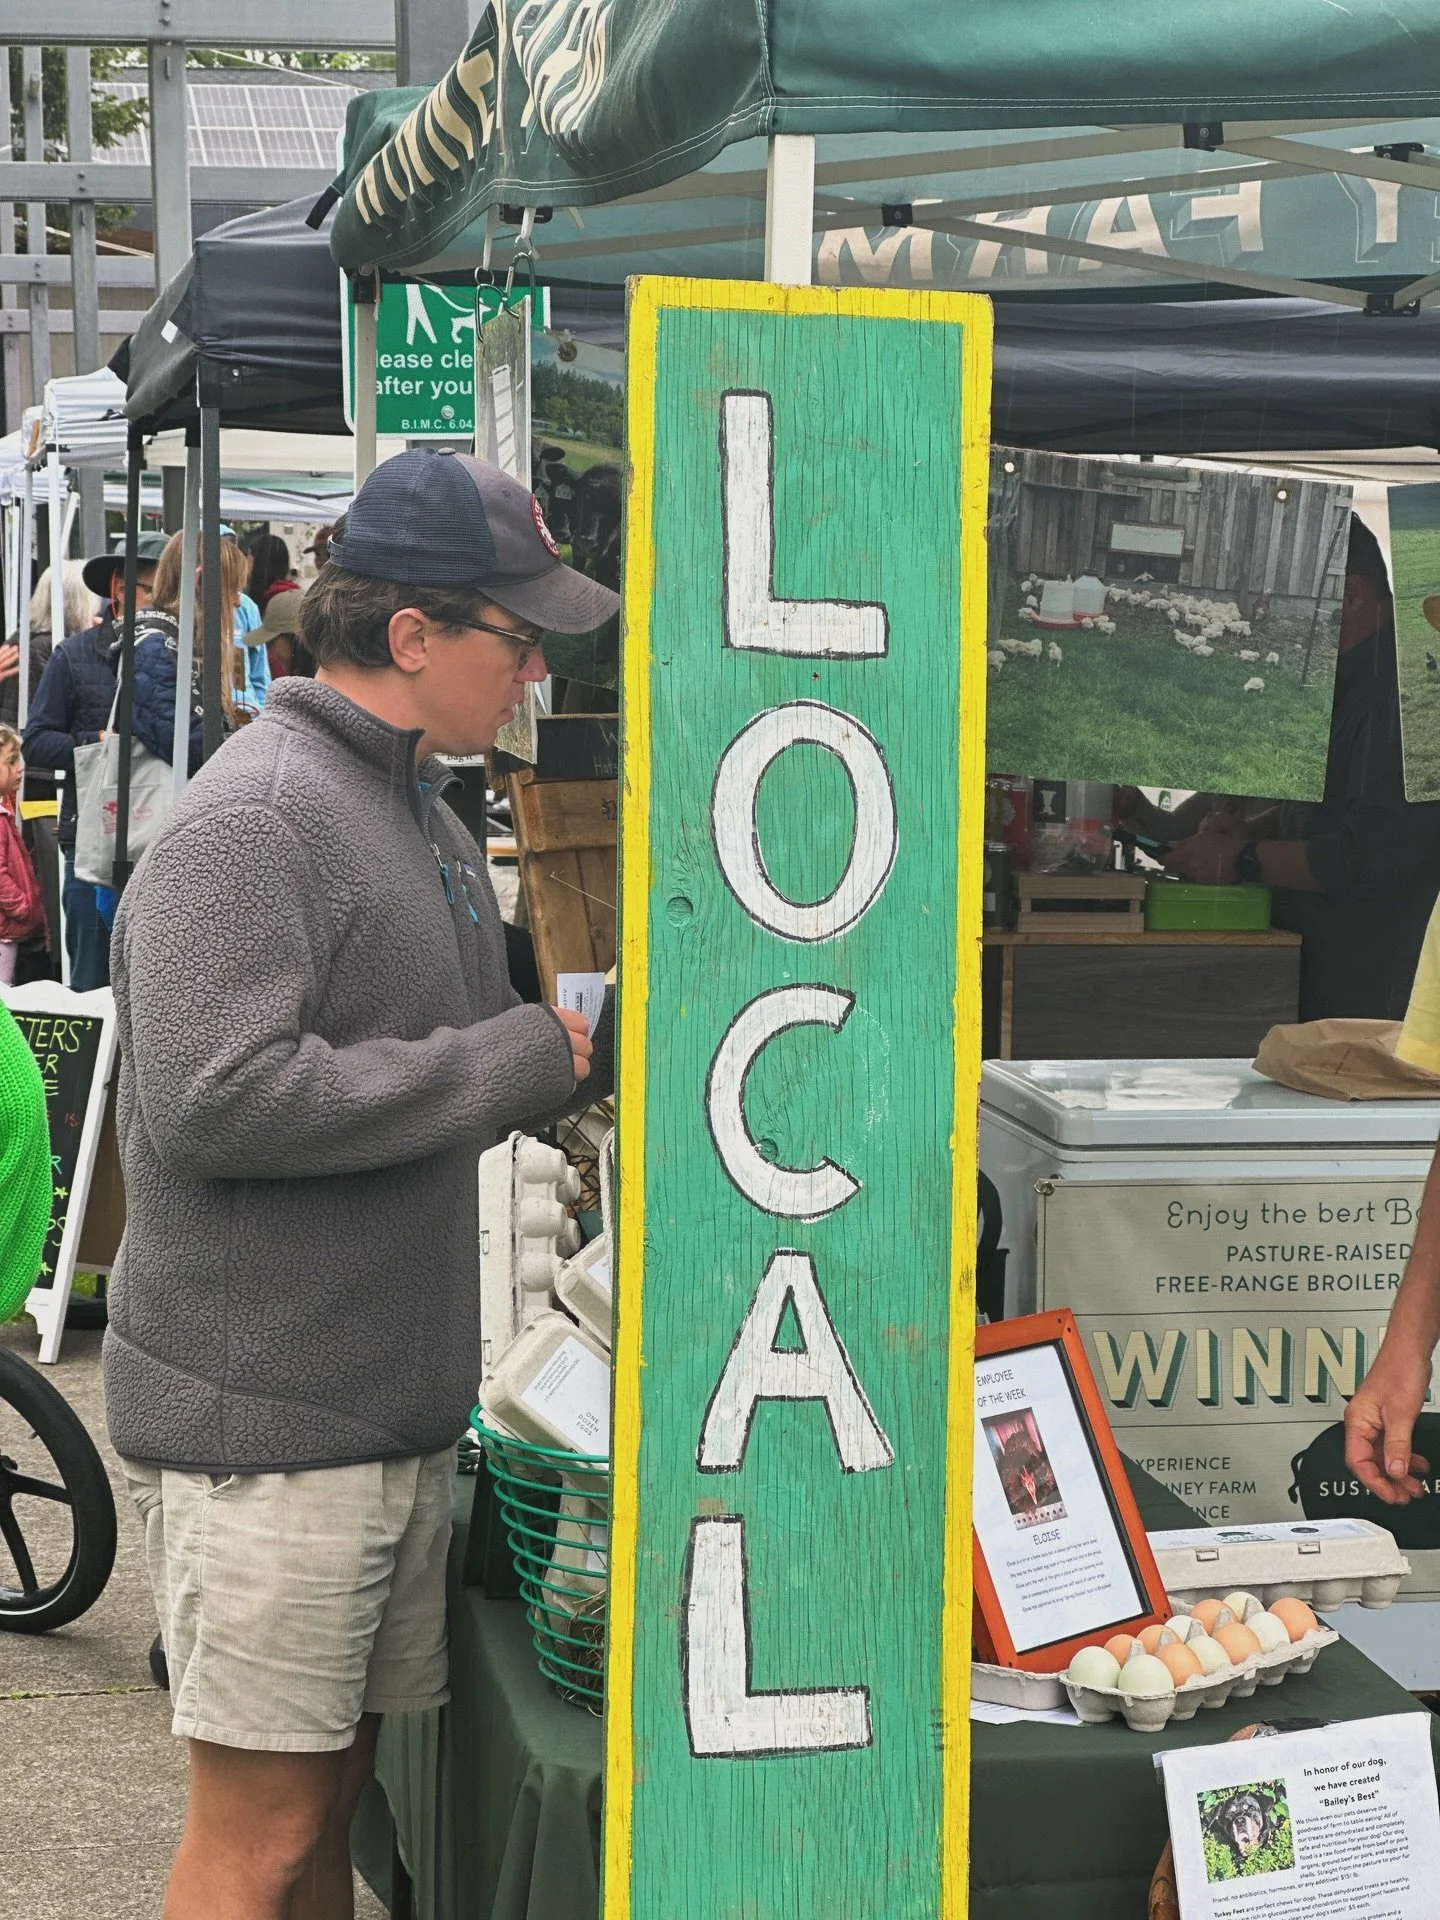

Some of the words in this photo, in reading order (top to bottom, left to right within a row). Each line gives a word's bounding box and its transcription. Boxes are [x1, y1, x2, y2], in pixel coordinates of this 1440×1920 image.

[440, 350, 474, 368] cle
[431, 380, 473, 400] you
[402, 419, 446, 430] B.I.M.C.
[450, 419, 475, 430] 6.04.
[681, 387, 898, 1758] LOCAL
[1167, 1200, 1248, 1231] Enjoy
[1261, 1202, 1307, 1224] the
[1318, 1201, 1376, 1223] best
[1226, 1243, 1412, 1262] PASTURE-RAISED
[1156, 1274, 1298, 1294] FREE-RANGE
[1307, 1273, 1400, 1292] BROILER
[1091, 1326, 1388, 1409] WINN
[976, 1369, 1014, 1386] EMPLOYEE
[976, 1396, 987, 1407] OF
[988, 1392, 1004, 1404] THE
[1004, 1388, 1026, 1401] WEEK
[578, 1414, 600, 1433] DOZEN
[586, 1412, 600, 1424] ONE
[576, 1421, 593, 1436] EGGS
[1132, 1457, 1230, 1472] XPERIENCE
[1210, 1481, 1256, 1494] FARM
[1033, 1529, 1061, 1546] ELOISE
[1303, 1768, 1312, 1776] In
[1313, 1765, 1338, 1775] honor
[1340, 1761, 1350, 1770] of
[1327, 1781, 1347, 1789] have
[1349, 1773, 1380, 1786] created
